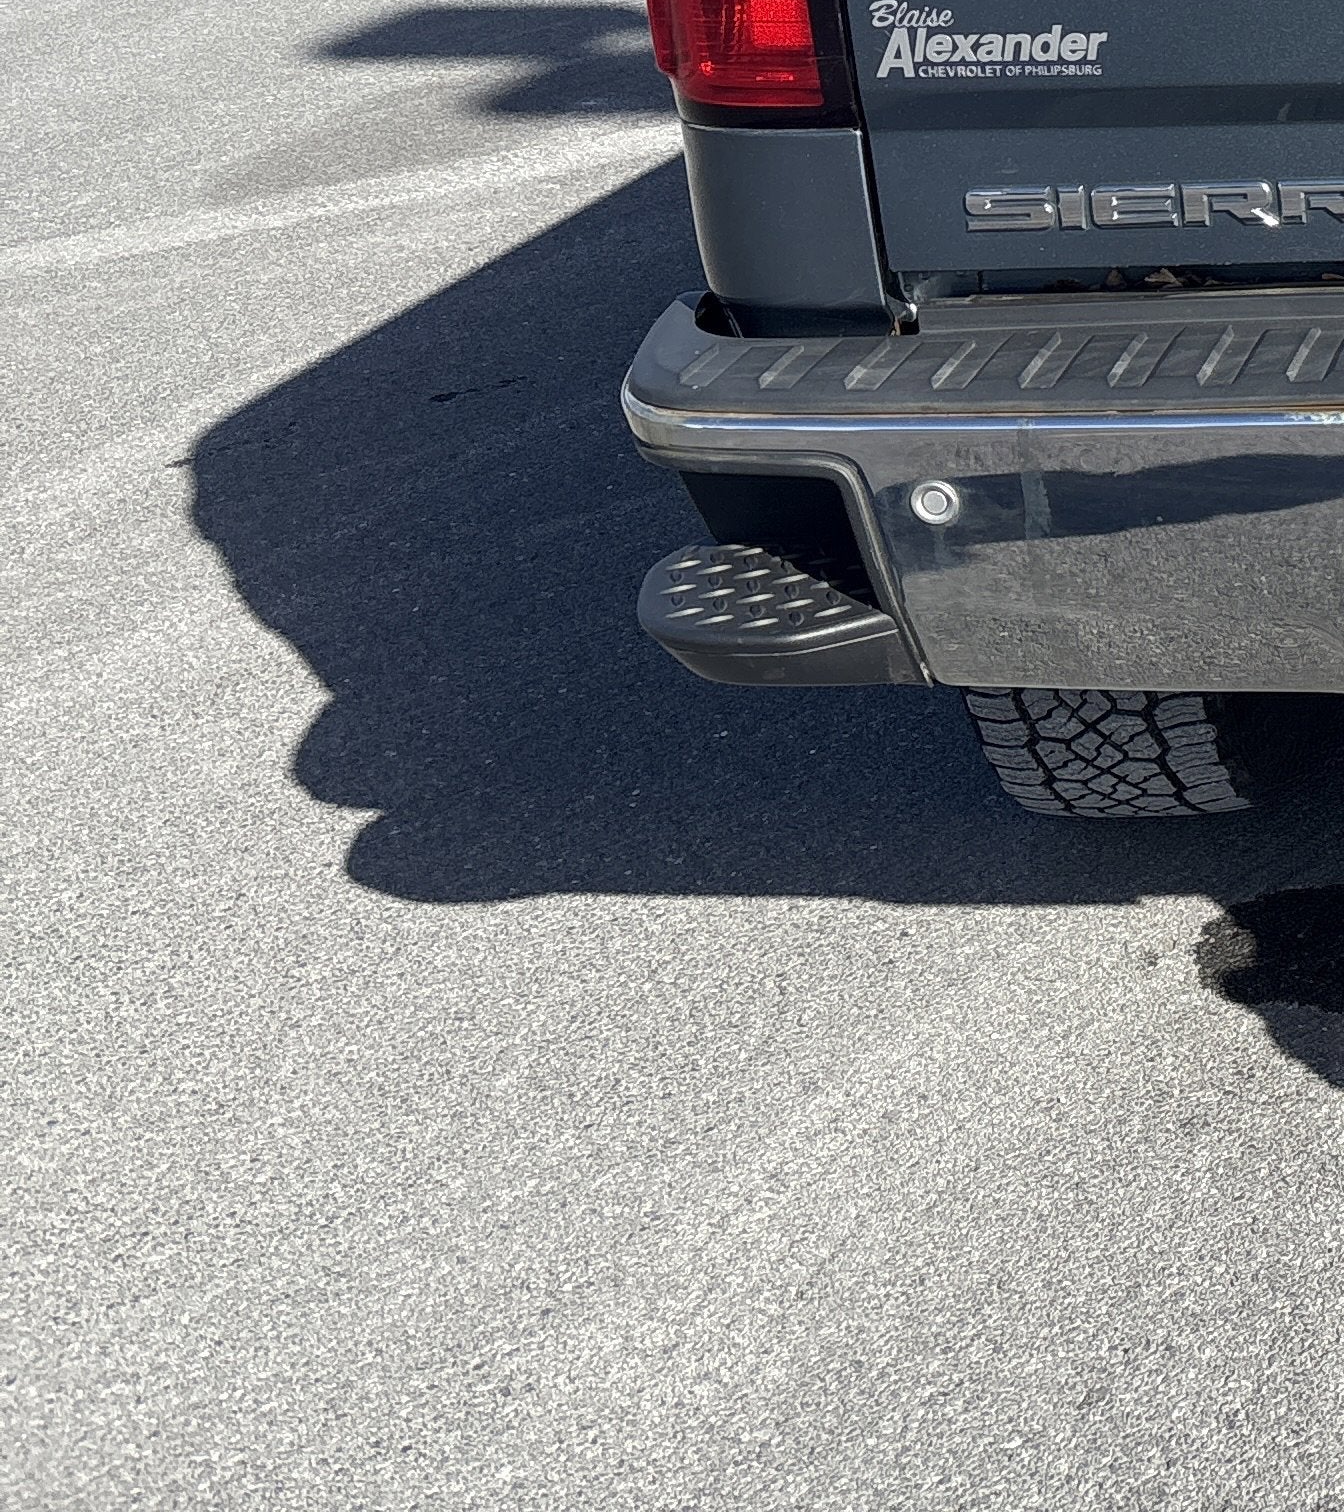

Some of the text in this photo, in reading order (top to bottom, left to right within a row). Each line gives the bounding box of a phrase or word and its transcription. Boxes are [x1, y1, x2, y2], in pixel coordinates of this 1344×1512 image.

[868, 0, 954, 28] Blaise
[876, 24, 1108, 78] Alexander
[918, 63, 1103, 78] CHEVROLET OF PHILIPSBURG
